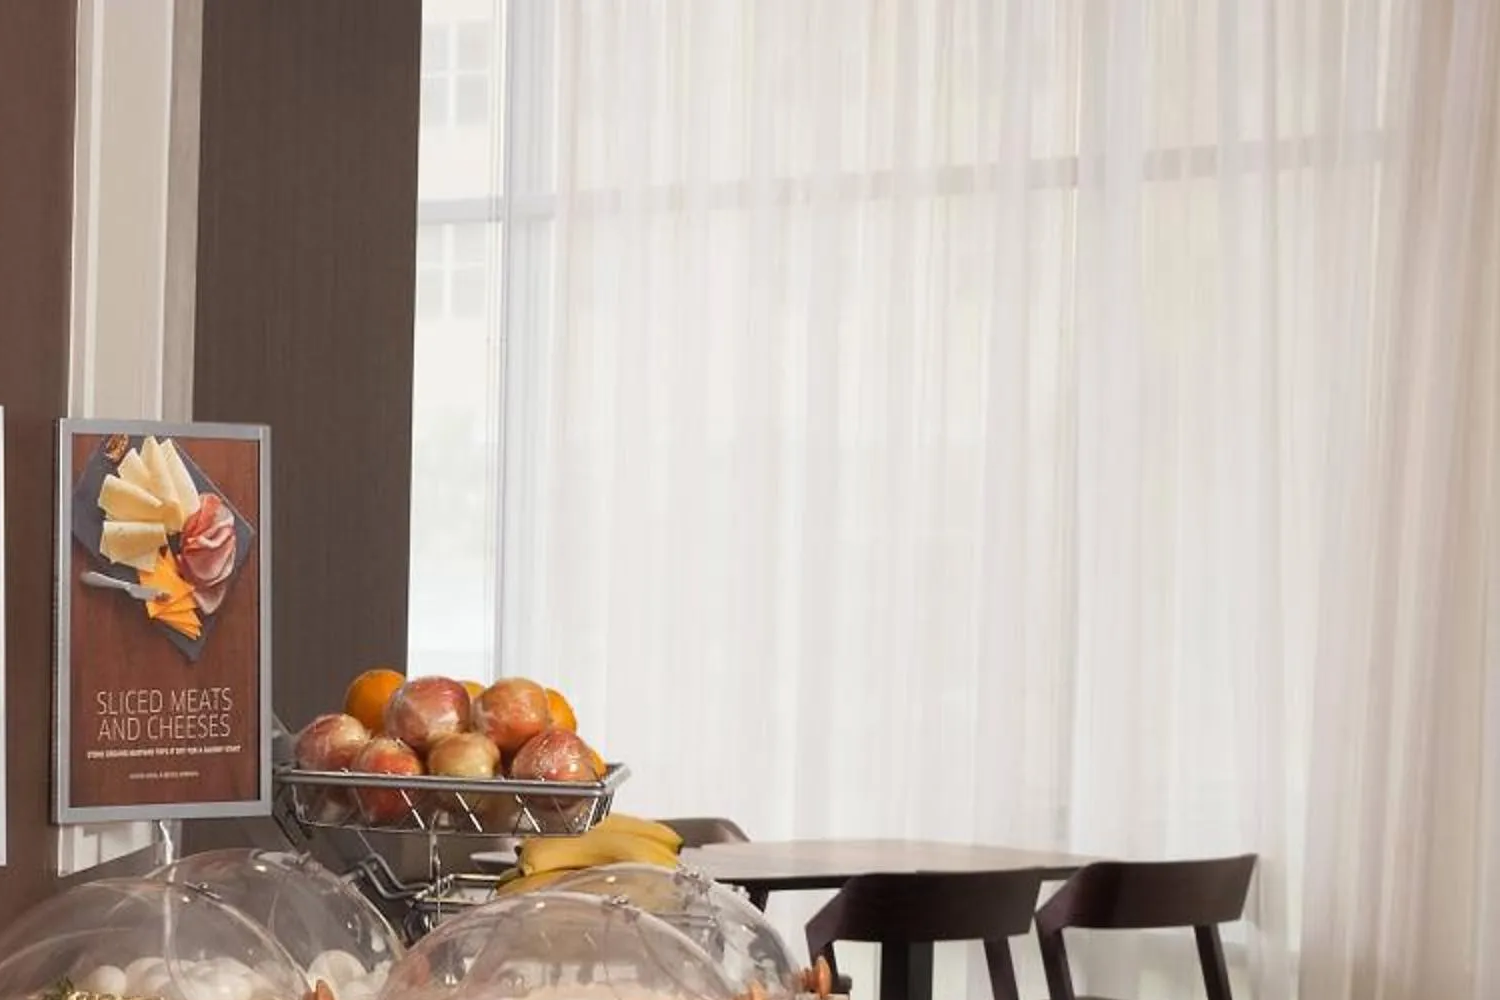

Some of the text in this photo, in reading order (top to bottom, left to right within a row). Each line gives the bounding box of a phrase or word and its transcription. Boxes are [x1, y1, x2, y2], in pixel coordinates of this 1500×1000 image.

[96, 687, 233, 715] SLICED MEATS
[98, 714, 231, 741] AND CHEESES
